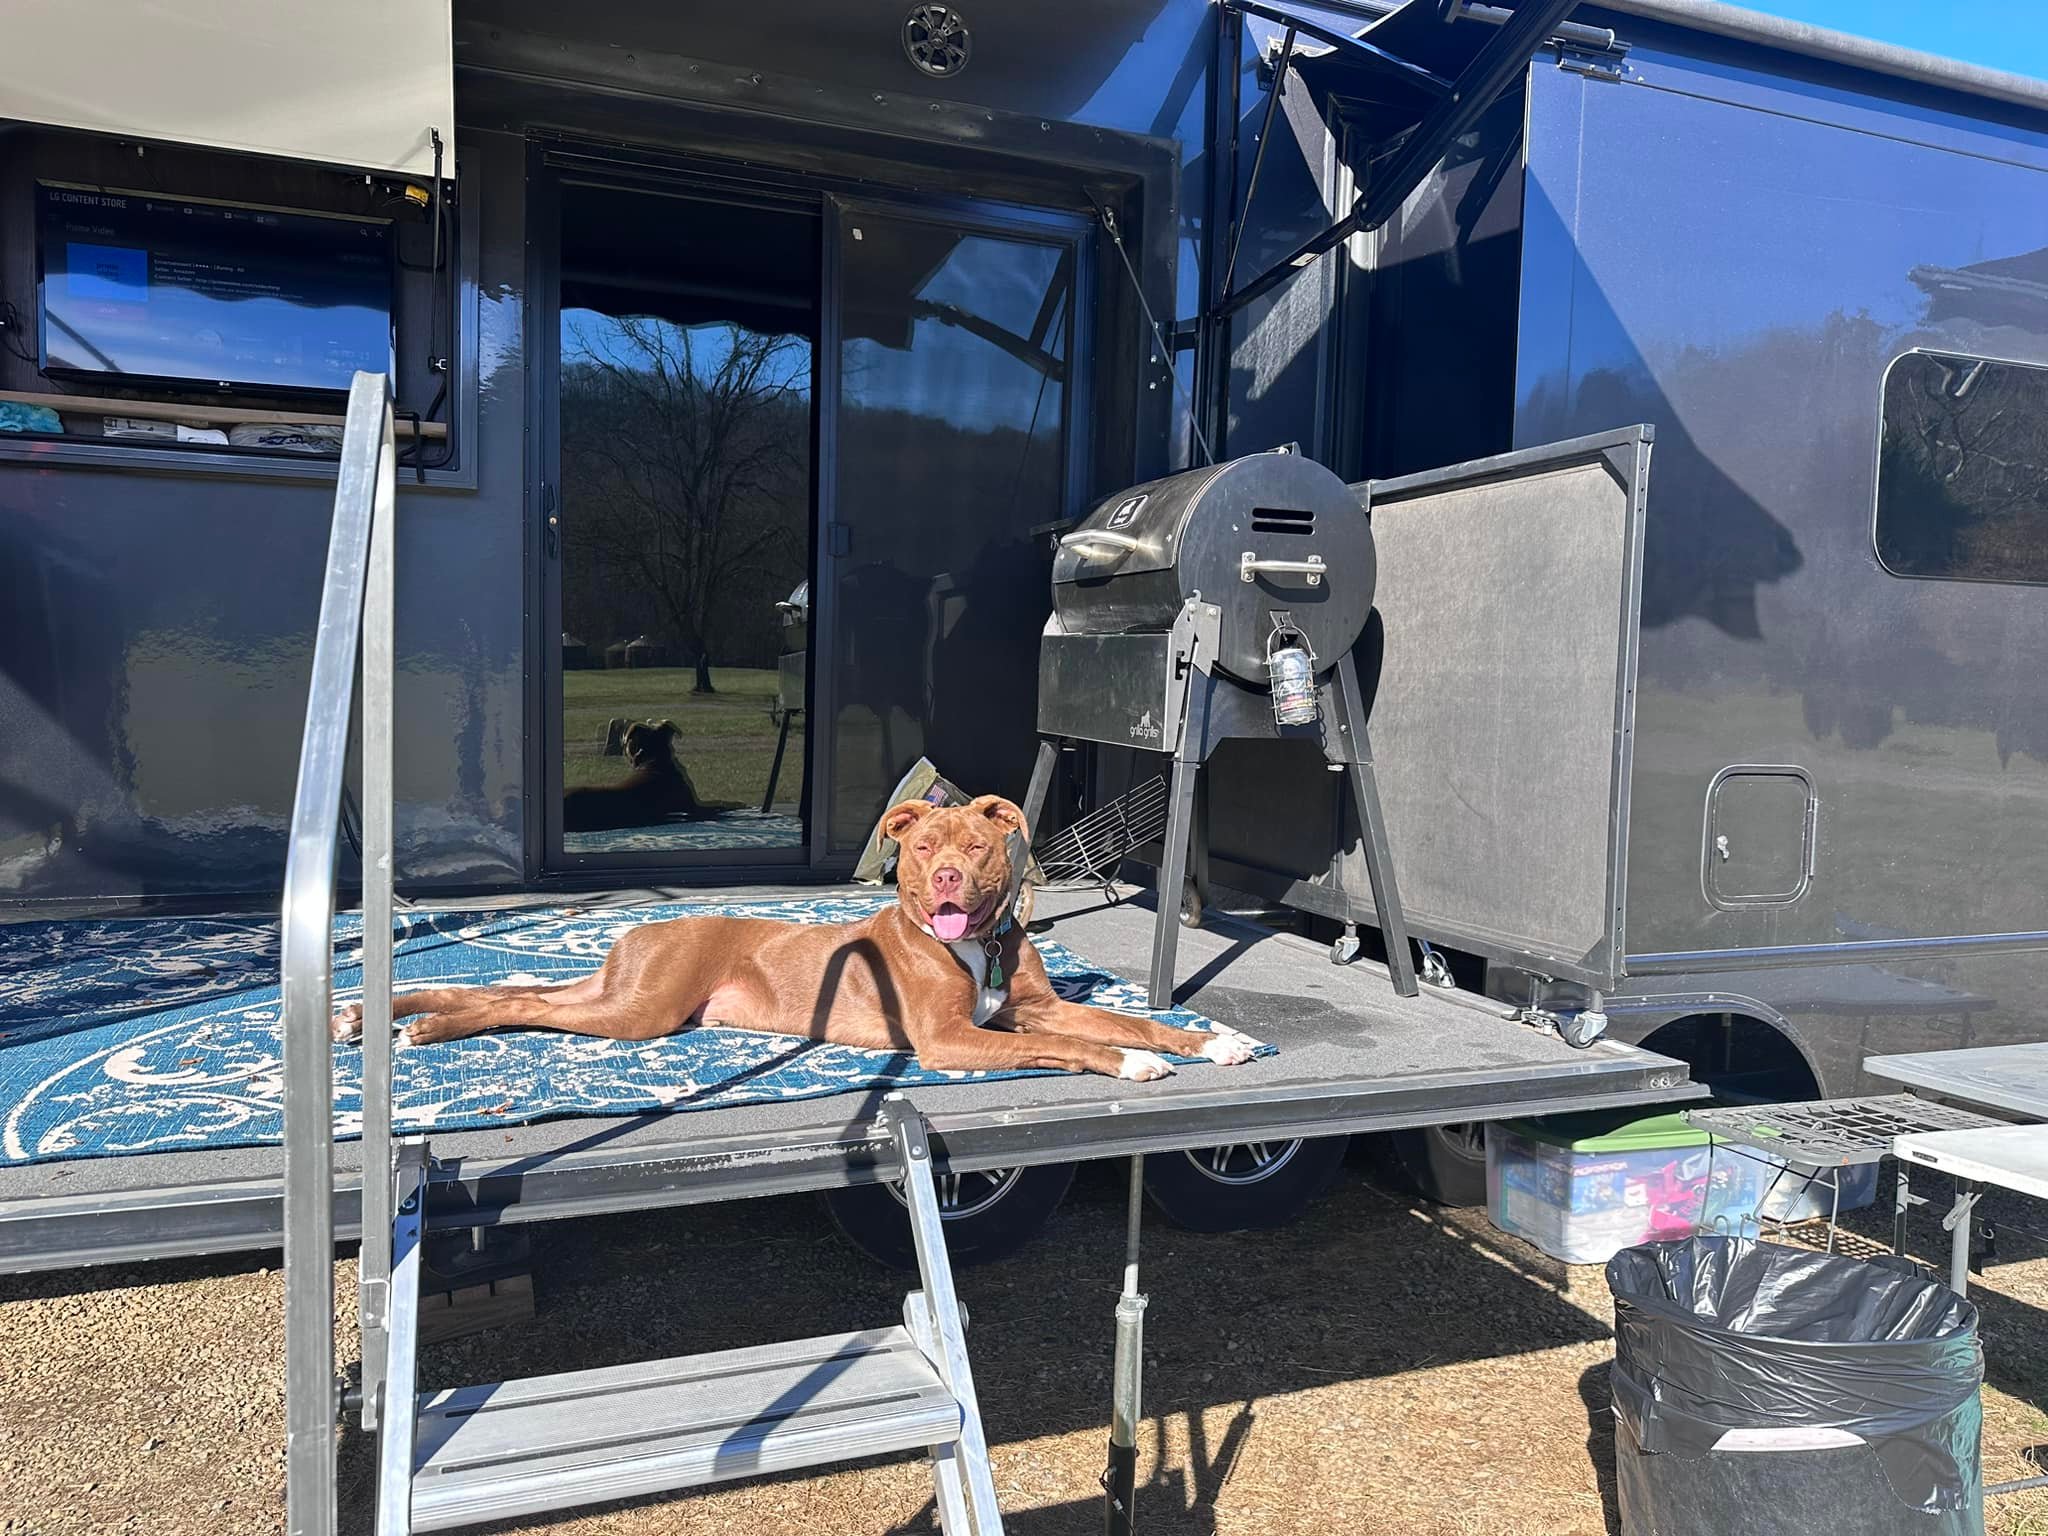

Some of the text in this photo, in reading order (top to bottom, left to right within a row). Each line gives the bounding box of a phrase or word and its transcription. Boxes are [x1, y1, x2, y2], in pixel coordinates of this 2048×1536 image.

[50, 192, 127, 209] LG CONTENT STORE
